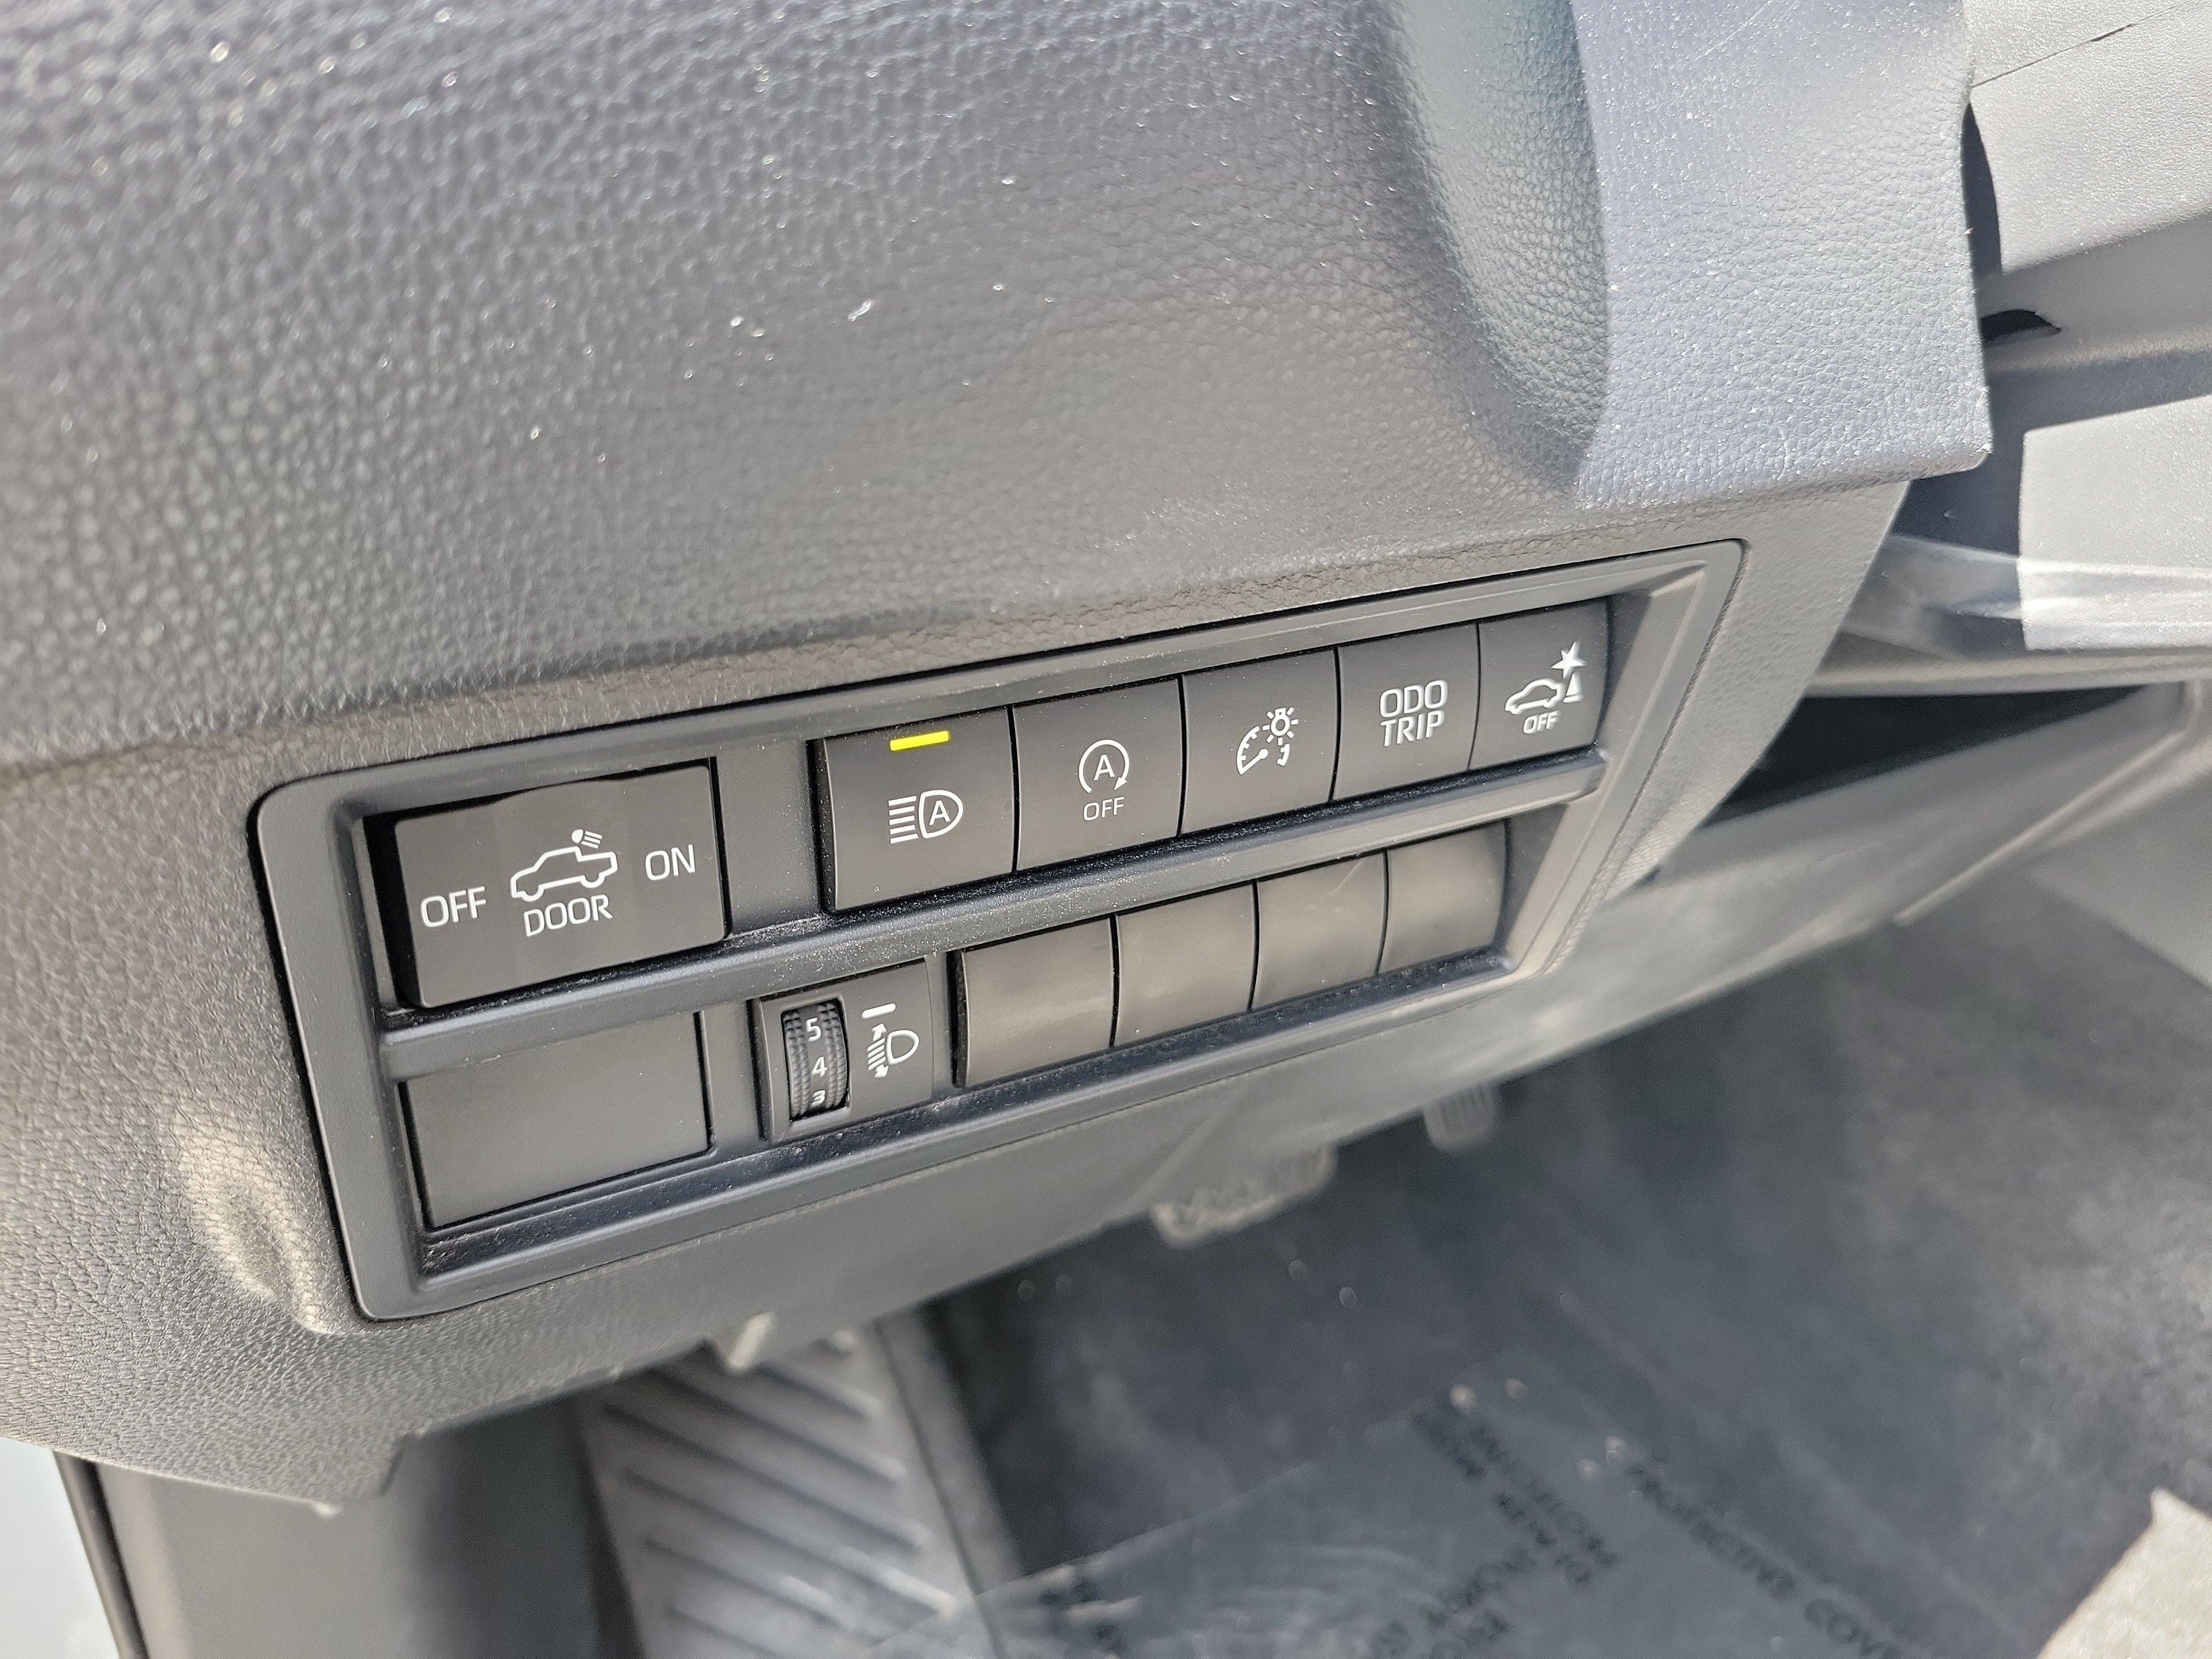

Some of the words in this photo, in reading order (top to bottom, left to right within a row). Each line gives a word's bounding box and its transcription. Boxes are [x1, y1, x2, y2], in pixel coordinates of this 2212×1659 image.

[1379, 679, 1447, 718] ODO
[1379, 711, 1444, 747] TRIP
[1522, 712, 1559, 734] OFF
[1093, 754, 1115, 781] A
[928, 799, 951, 826] A
[1083, 796, 1125, 821] OFF
[645, 844, 696, 881] ON
[420, 885, 487, 928] OFF
[523, 894, 613, 937] DOOR
[805, 1017, 822, 1042] 5
[811, 1056, 828, 1077] 4
[811, 1089, 826, 1107] 3
